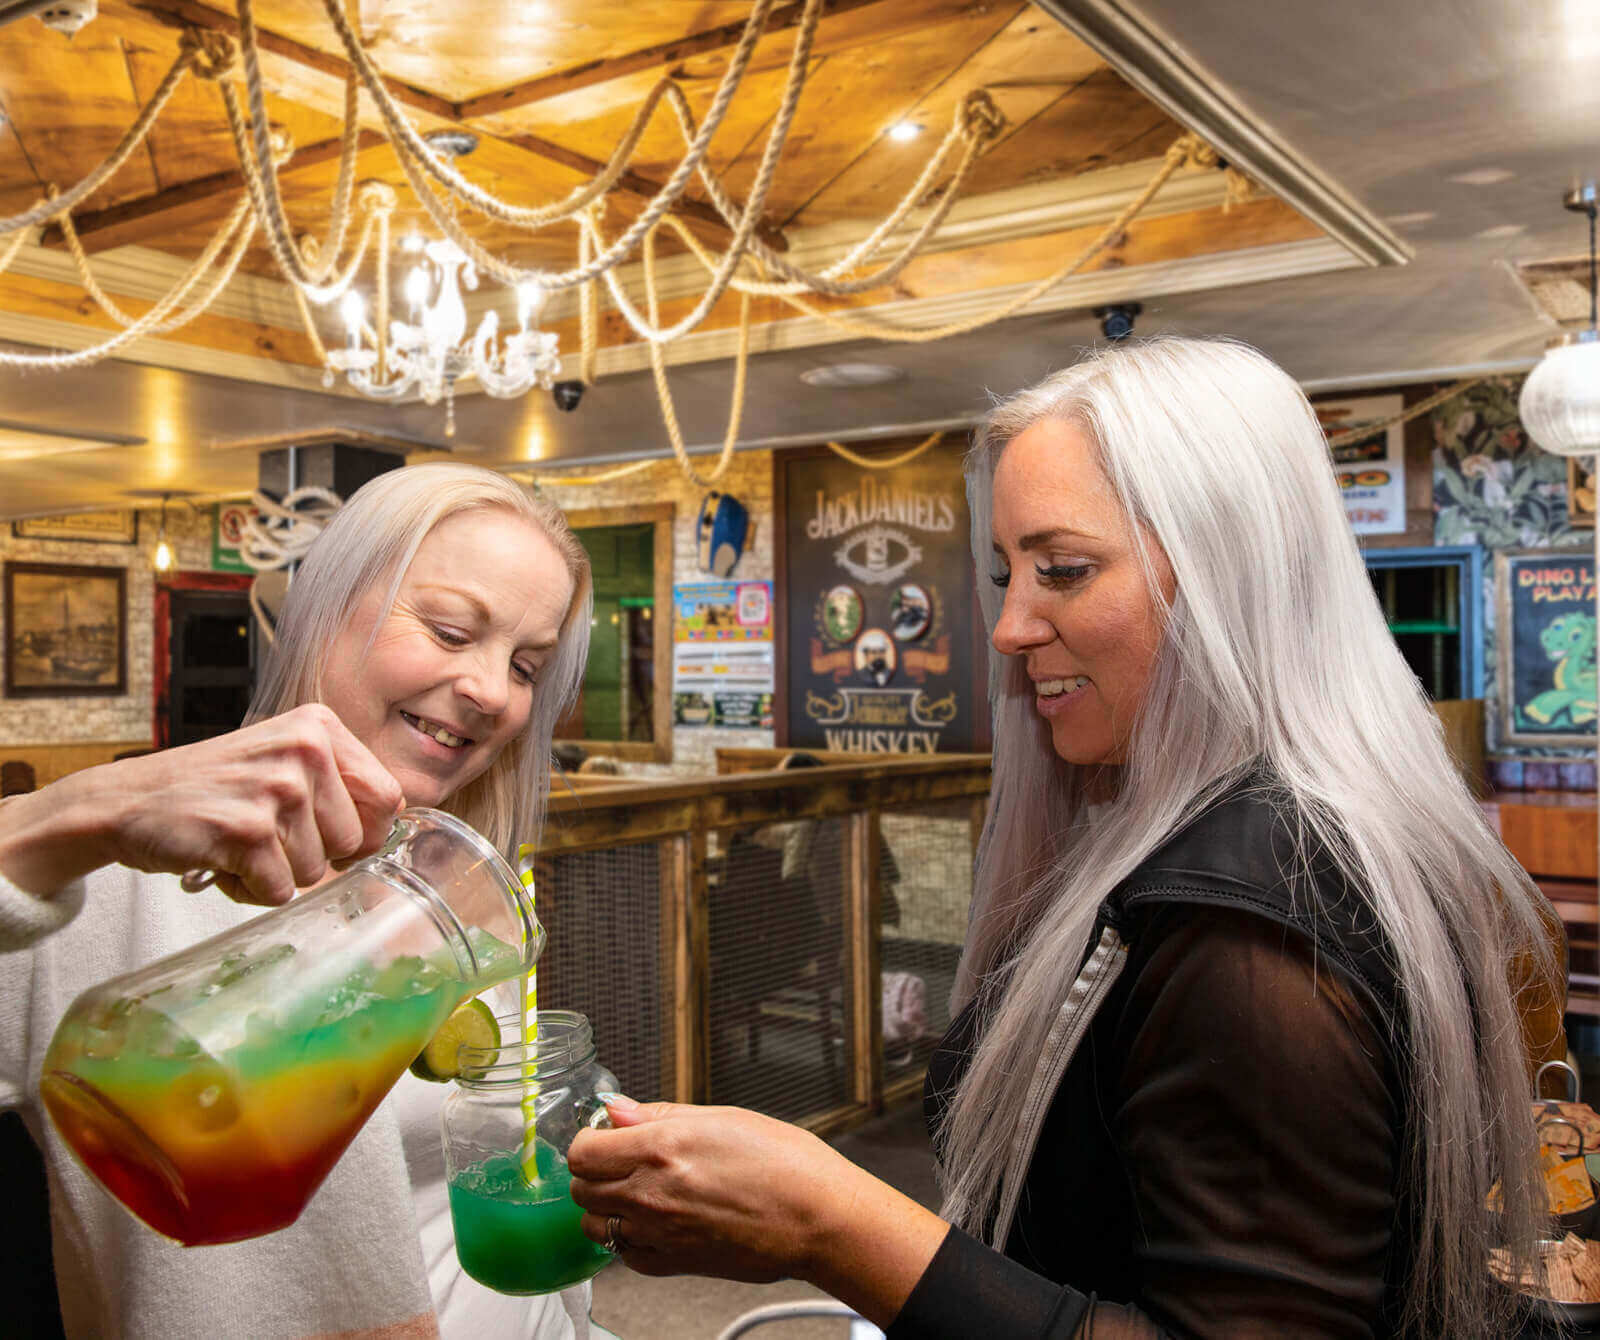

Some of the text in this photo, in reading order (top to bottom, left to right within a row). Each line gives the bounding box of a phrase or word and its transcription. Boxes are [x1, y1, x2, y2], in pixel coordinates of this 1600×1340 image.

[806, 490, 858, 539] JACK
[1518, 568, 1575, 587] DINO
[825, 729, 940, 754] WHISKEY
